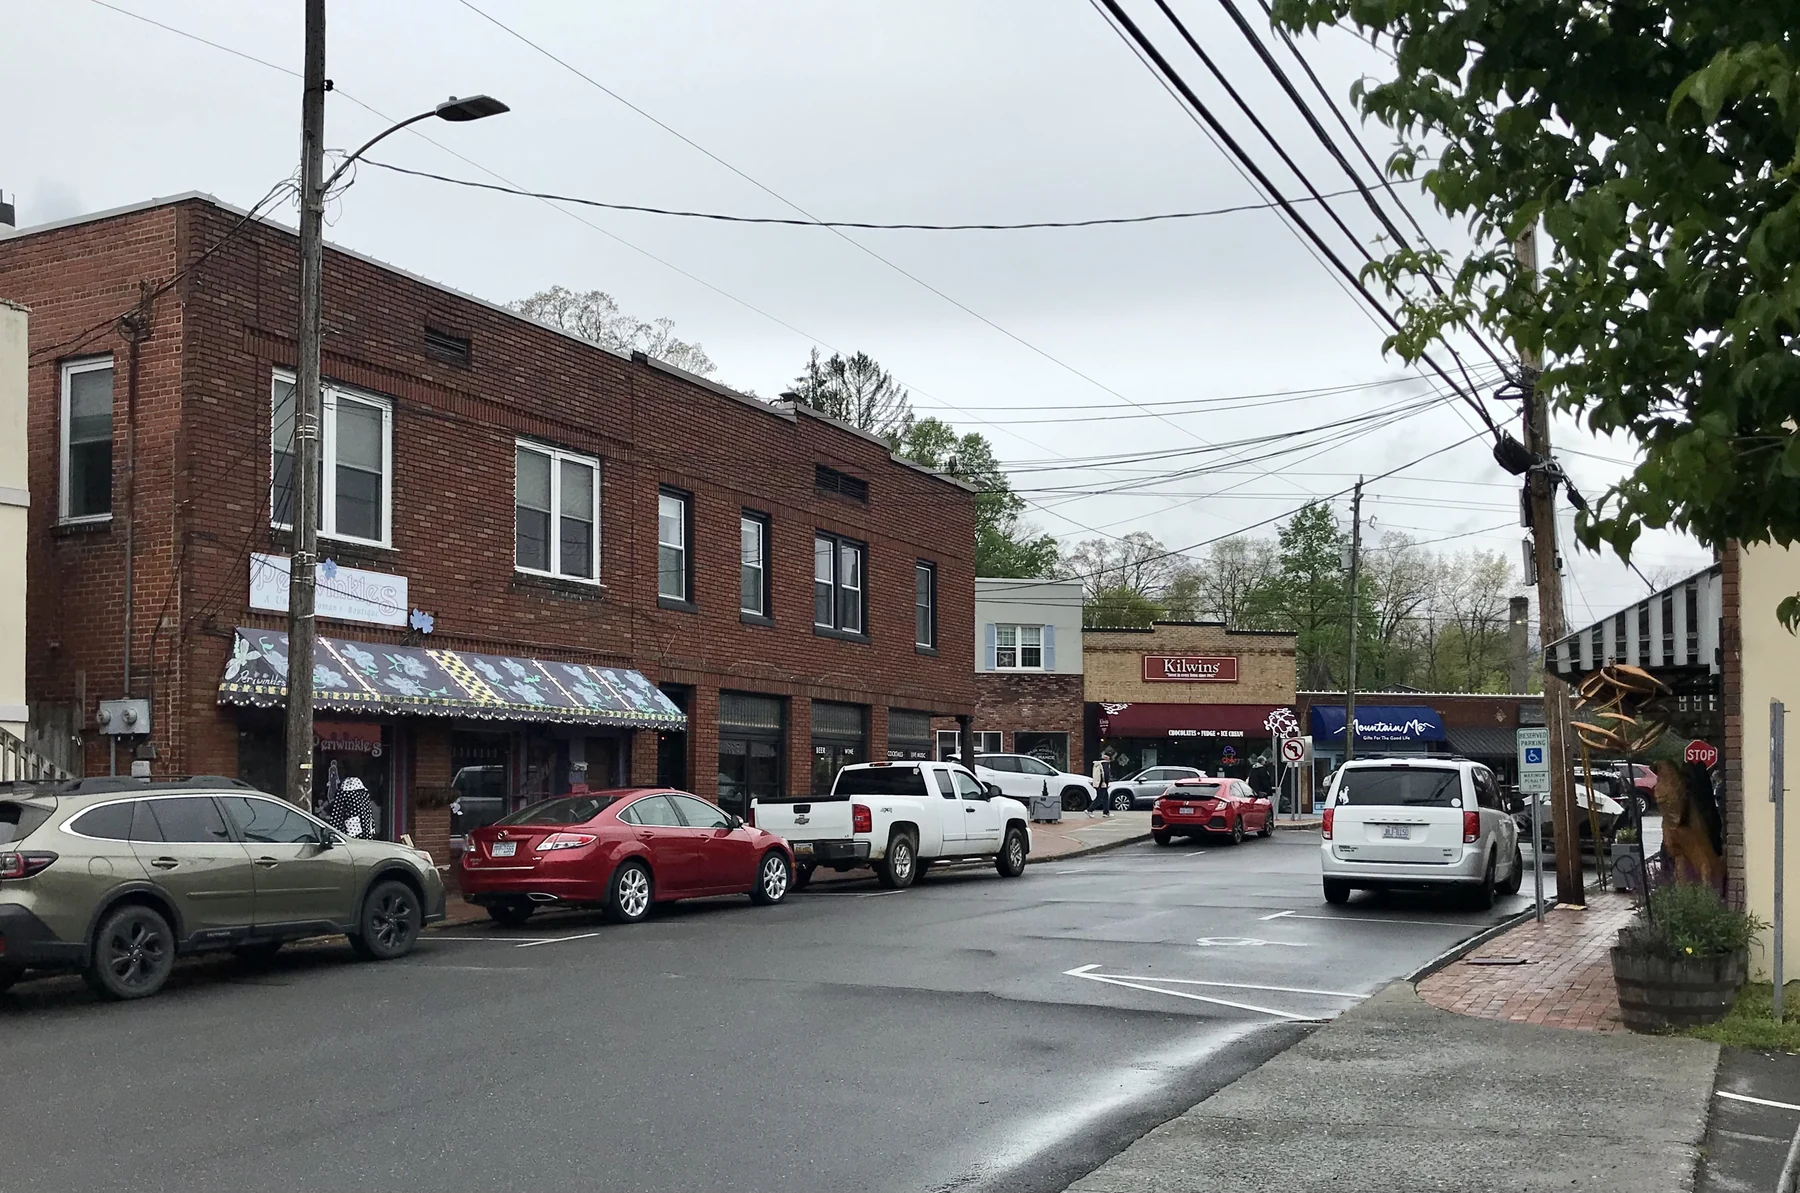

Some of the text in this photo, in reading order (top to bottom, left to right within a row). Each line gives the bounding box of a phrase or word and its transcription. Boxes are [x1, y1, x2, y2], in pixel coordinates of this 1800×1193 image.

[1163, 658, 1219, 673] Kilwins
[236, 670, 287, 686] Periwinkles
[1687, 749, 1715, 761] STOP
